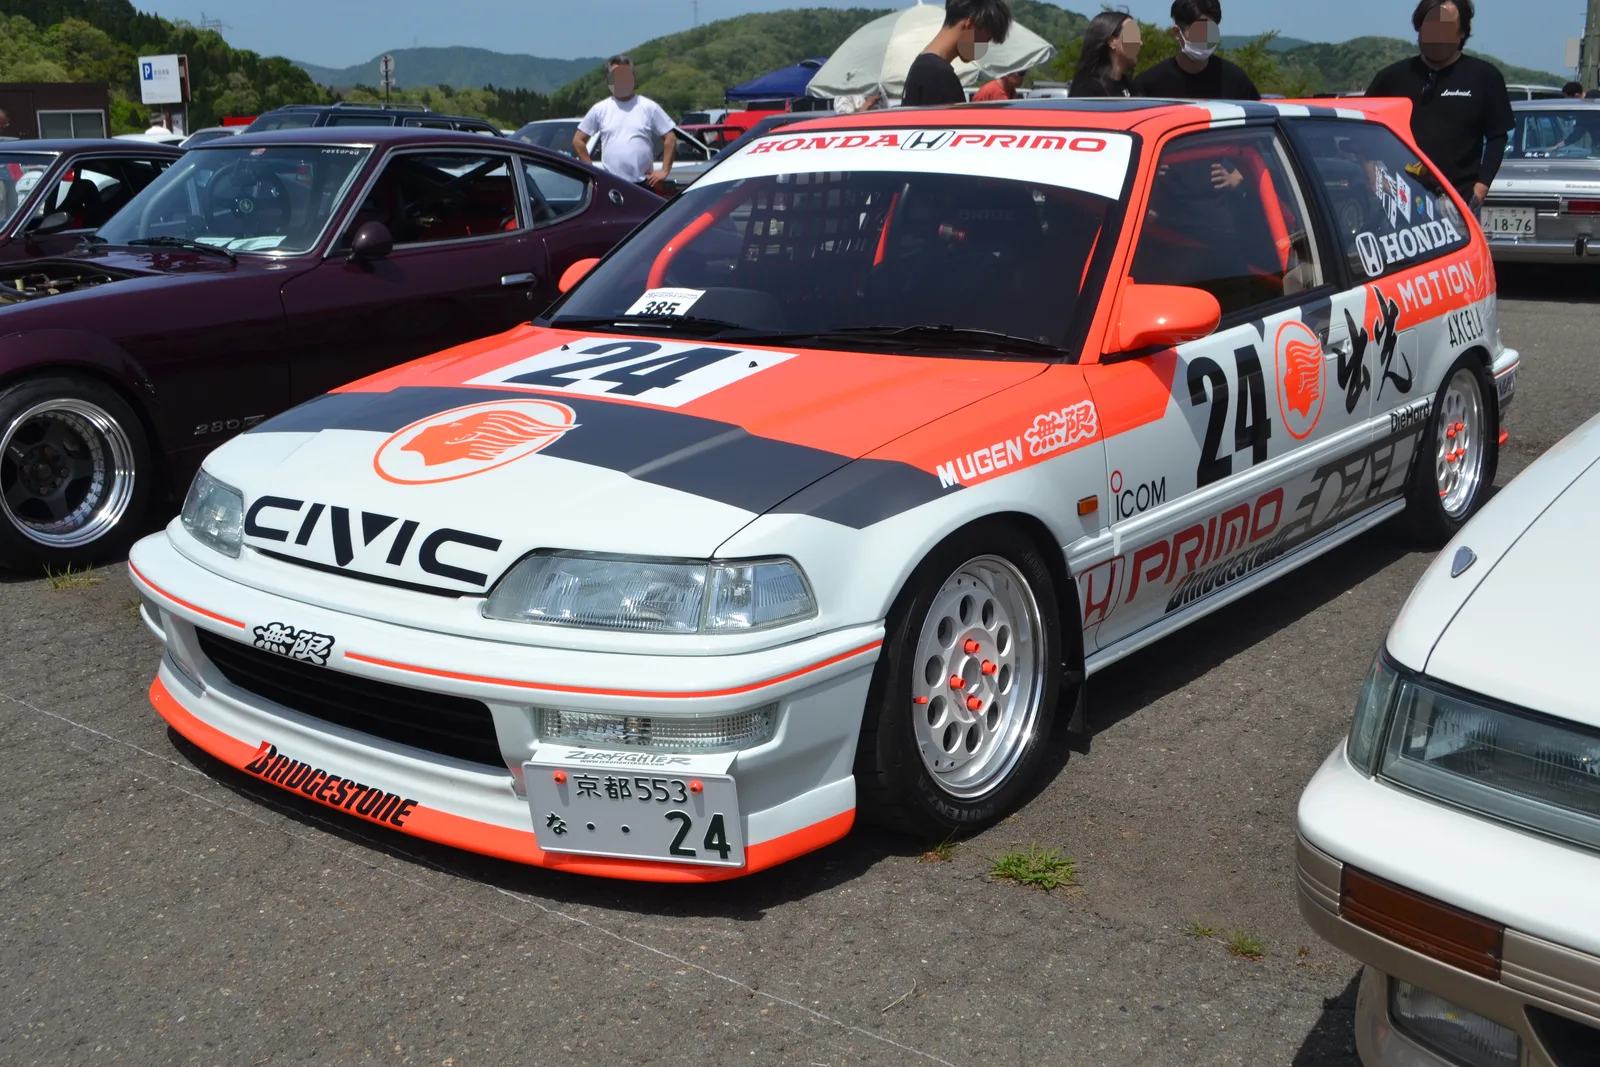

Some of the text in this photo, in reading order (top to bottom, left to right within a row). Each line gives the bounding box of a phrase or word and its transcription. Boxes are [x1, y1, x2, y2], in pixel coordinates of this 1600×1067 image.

[321, 148, 360, 156] restored
[746, 133, 1107, 156] HONDA PRIMO
[1379, 217, 1462, 265] HONDA
[640, 300, 682, 316] 385
[1396, 260, 1477, 313] MOTION
[501, 341, 743, 397] 24
[1186, 343, 1272, 490] 24
[1389, 396, 1430, 434] DieHard
[936, 400, 1098, 489] MUGEN 無限
[244, 495, 503, 587] CIVIC
[1125, 487, 1284, 605] PRIMO
[252, 621, 336, 667] 無限
[244, 740, 419, 828] BRIDGESTONE
